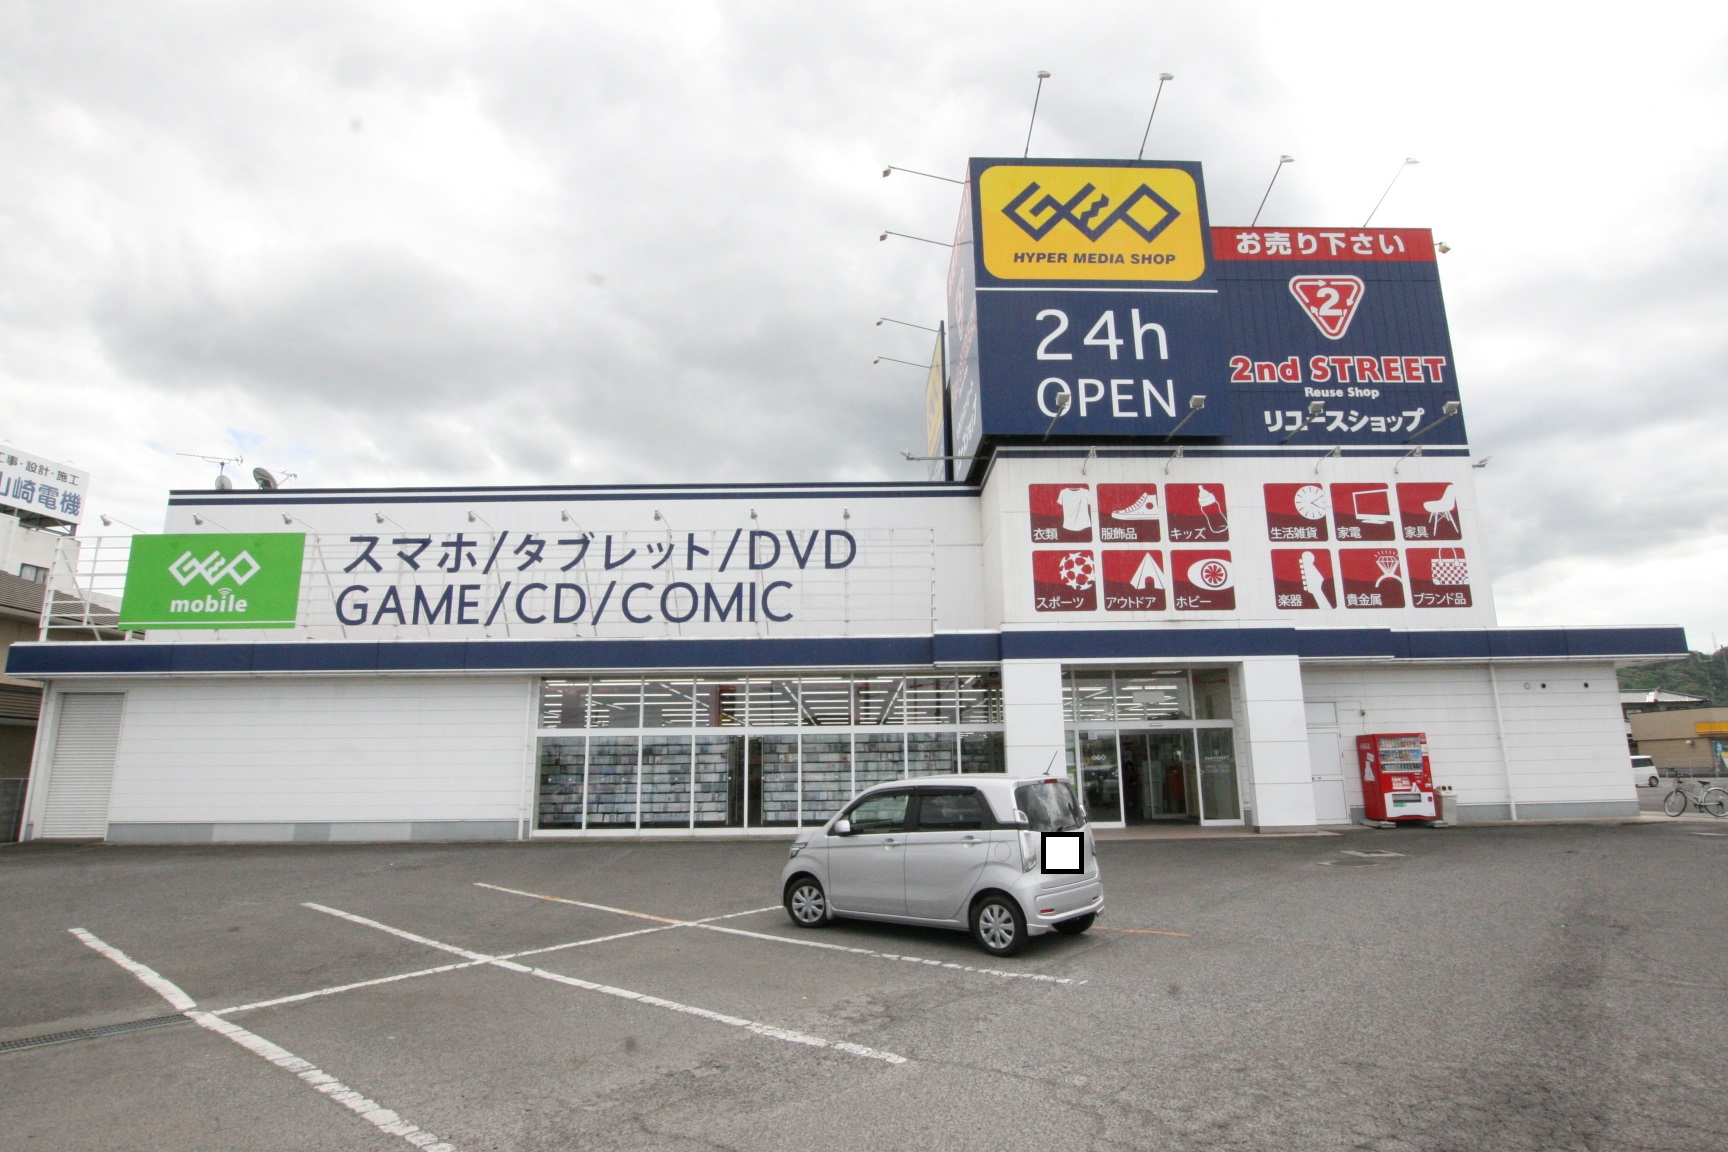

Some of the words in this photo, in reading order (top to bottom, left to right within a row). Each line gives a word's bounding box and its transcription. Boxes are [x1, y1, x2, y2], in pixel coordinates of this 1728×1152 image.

[1236, 232, 1405, 256] お売り下さい
[1013, 252, 1068, 263] HYPER
[1073, 253, 1125, 264] MEDIA
[1130, 253, 1176, 265] SHOP
[1316, 287, 1344, 316] 2
[1035, 308, 1169, 361] 24h
[1229, 355, 1302, 383] 2nd
[1309, 355, 1447, 383] STREET
[1037, 377, 1177, 418] OPEN
[1304, 386, 1344, 398] Reuse
[1347, 386, 1380, 399] Shop
[1264, 407, 1425, 433] リユースショップ
[1033, 527, 1059, 541] 衣類
[1101, 527, 1138, 540] 服飾品
[1170, 527, 1206, 540] キッズ
[1270, 526, 1318, 539] 生活雑貨
[1337, 526, 1362, 539] 家電
[1404, 526, 1429, 538] 家具
[343, 528, 857, 575] スマホ/タブレット/DVD
[170, 594, 248, 613] mobile
[335, 580, 795, 627] GAME/CD/COMIC
[1036, 596, 1084, 610] スポーツ
[1105, 596, 1156, 609] アウトドア
[1176, 596, 1212, 609] ホビー
[1277, 593, 1303, 607] 楽器
[1346, 593, 1383, 606] 貴金属
[1413, 592, 1467, 606] ブランド品
